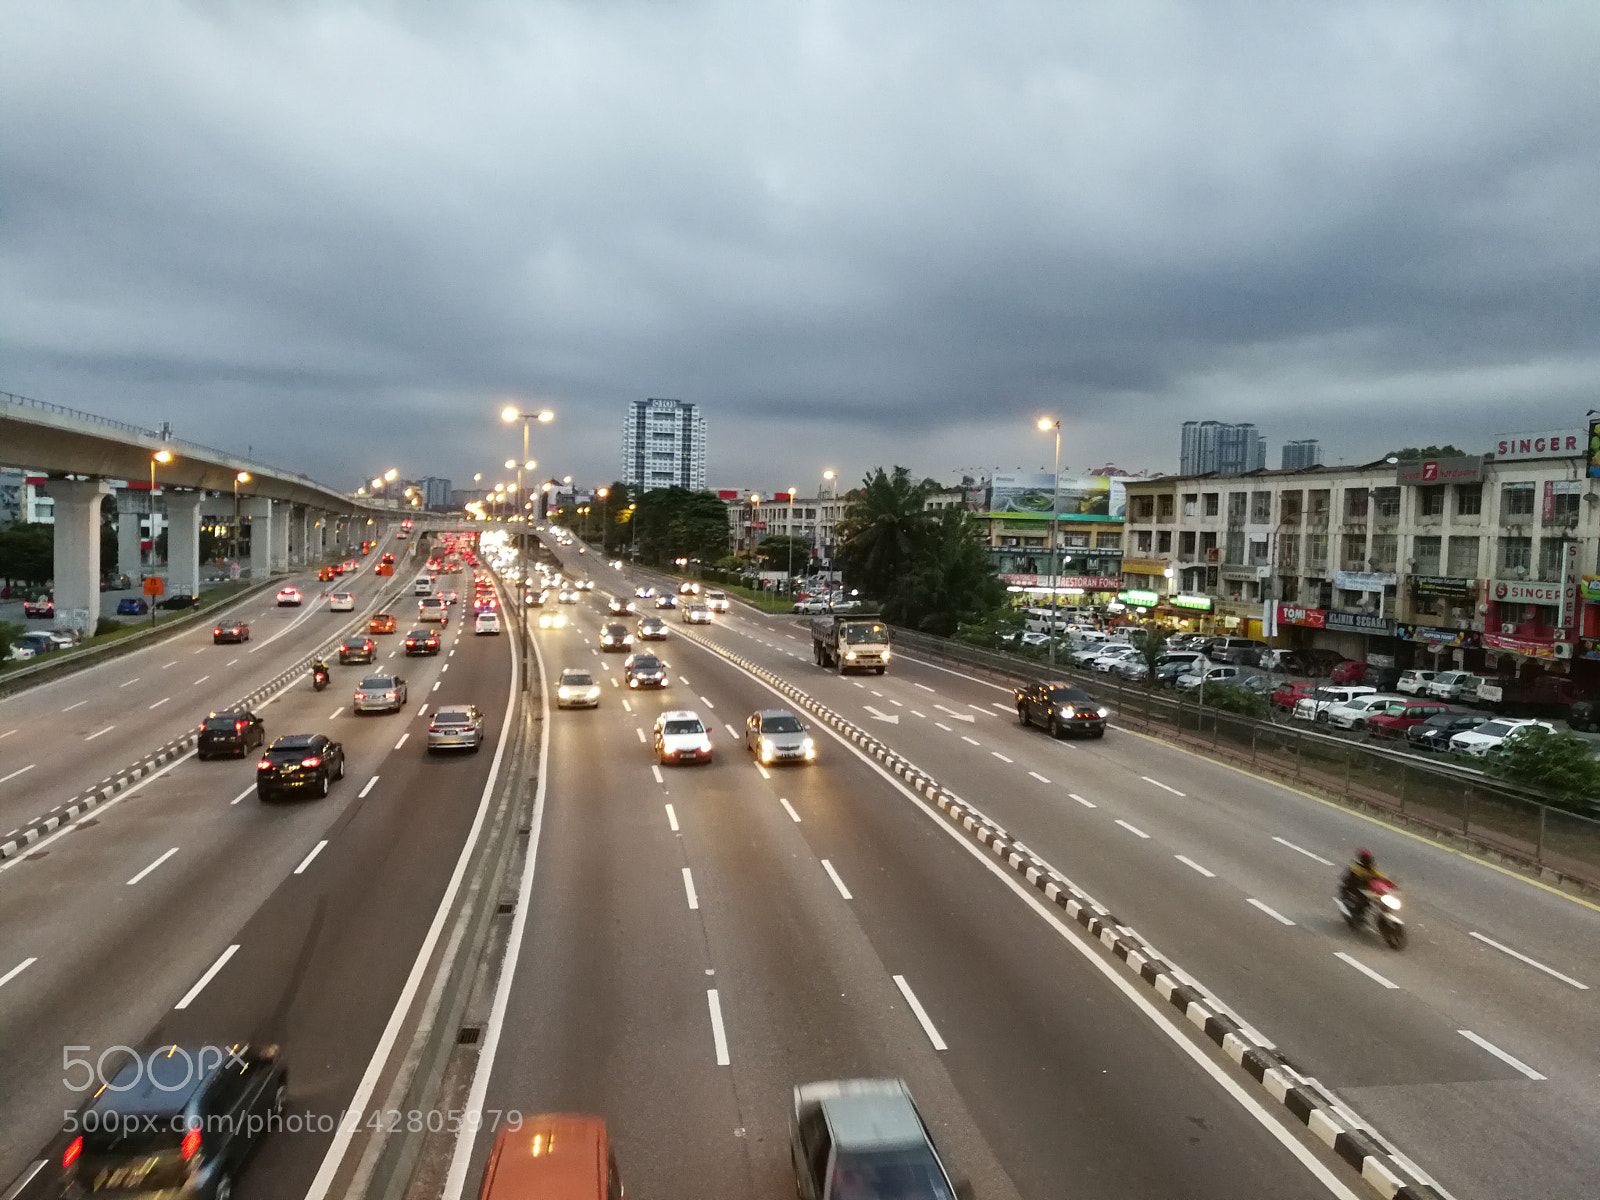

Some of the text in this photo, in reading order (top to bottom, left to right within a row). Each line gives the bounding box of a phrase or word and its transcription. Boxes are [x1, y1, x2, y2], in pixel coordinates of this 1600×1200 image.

[1498, 436, 1577, 455] SINGER
[1061, 577, 1119, 588] RESTORAN FONG
[1564, 546, 1577, 626] SINGER
[1283, 608, 1306, 619] TOMI
[1329, 613, 1354, 625] KLINIK
